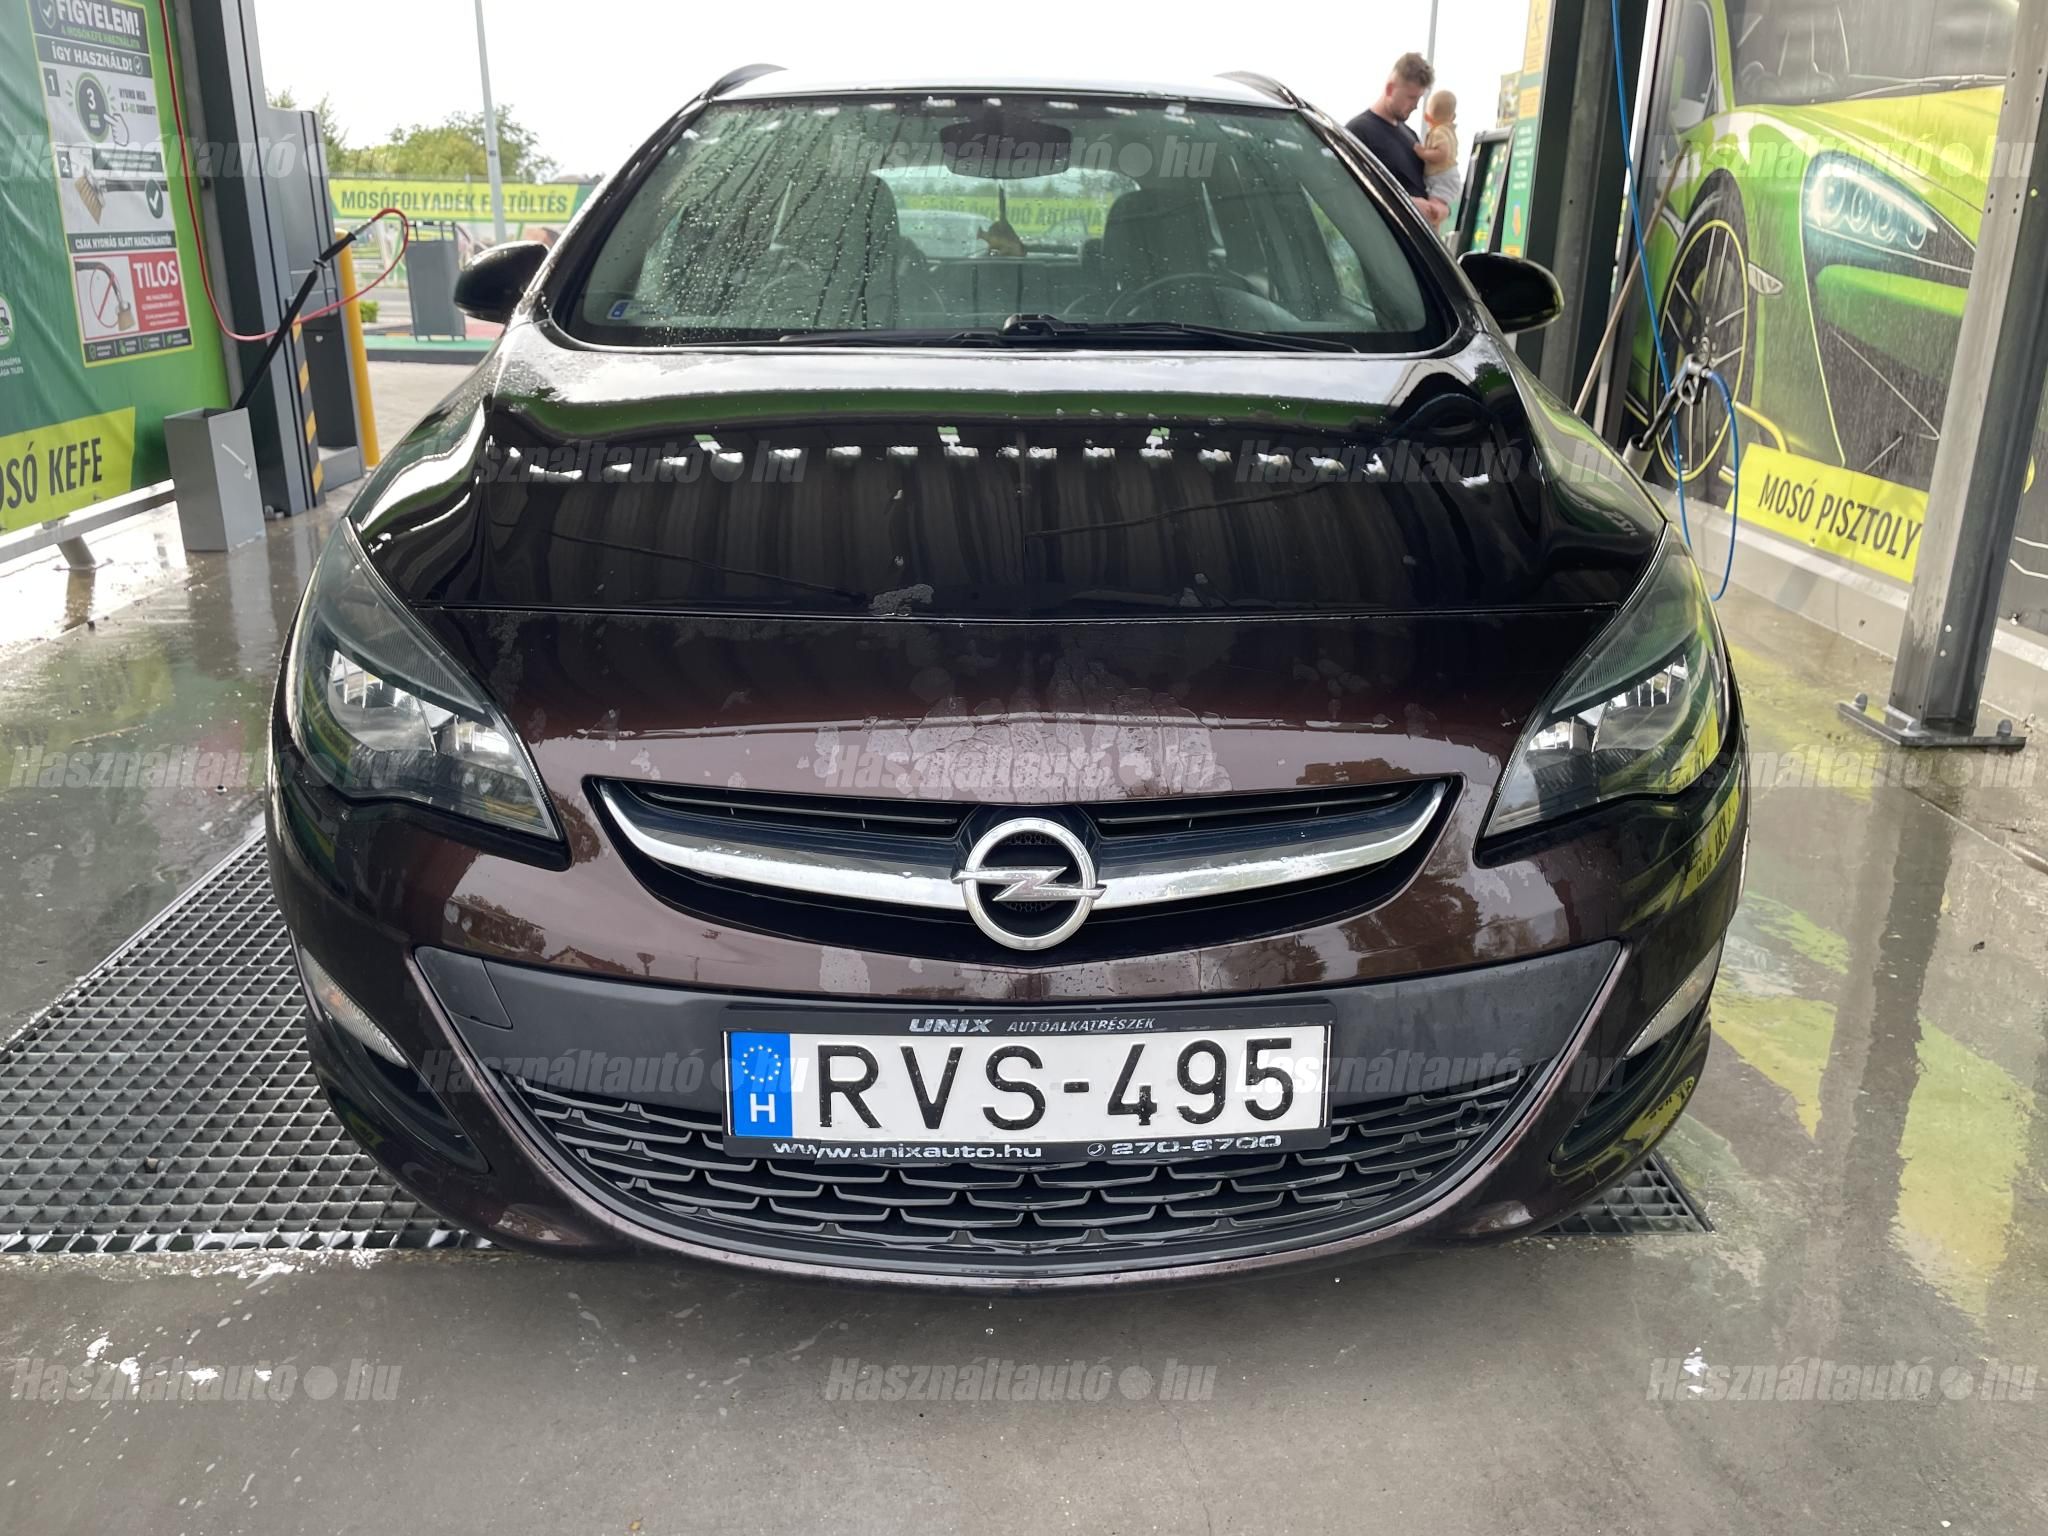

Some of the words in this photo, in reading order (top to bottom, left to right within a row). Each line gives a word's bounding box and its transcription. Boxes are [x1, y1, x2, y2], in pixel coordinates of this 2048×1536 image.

[57, 0, 140, 36] FIGYELEM!
[51, 41, 71, 62] ÍGY
[74, 49, 133, 71] HASZNÁLD!
[48, 75, 55, 91] 1
[87, 88, 96, 110] 3
[61, 156, 70, 173] 2
[341, 187, 475, 213] MOSÓFOLYADÉK
[75, 239, 92, 249] CSAK
[133, 260, 178, 289] TILOS
[48, 437, 102, 496] KEFE
[1758, 472, 1817, 523] MOSÓ
[1815, 495, 1922, 560] PISZTOLY
[909, 1018, 993, 1033] UNIX
[817, 1037, 1294, 1131] RVS-495
[750, 1093, 776, 1123] H
